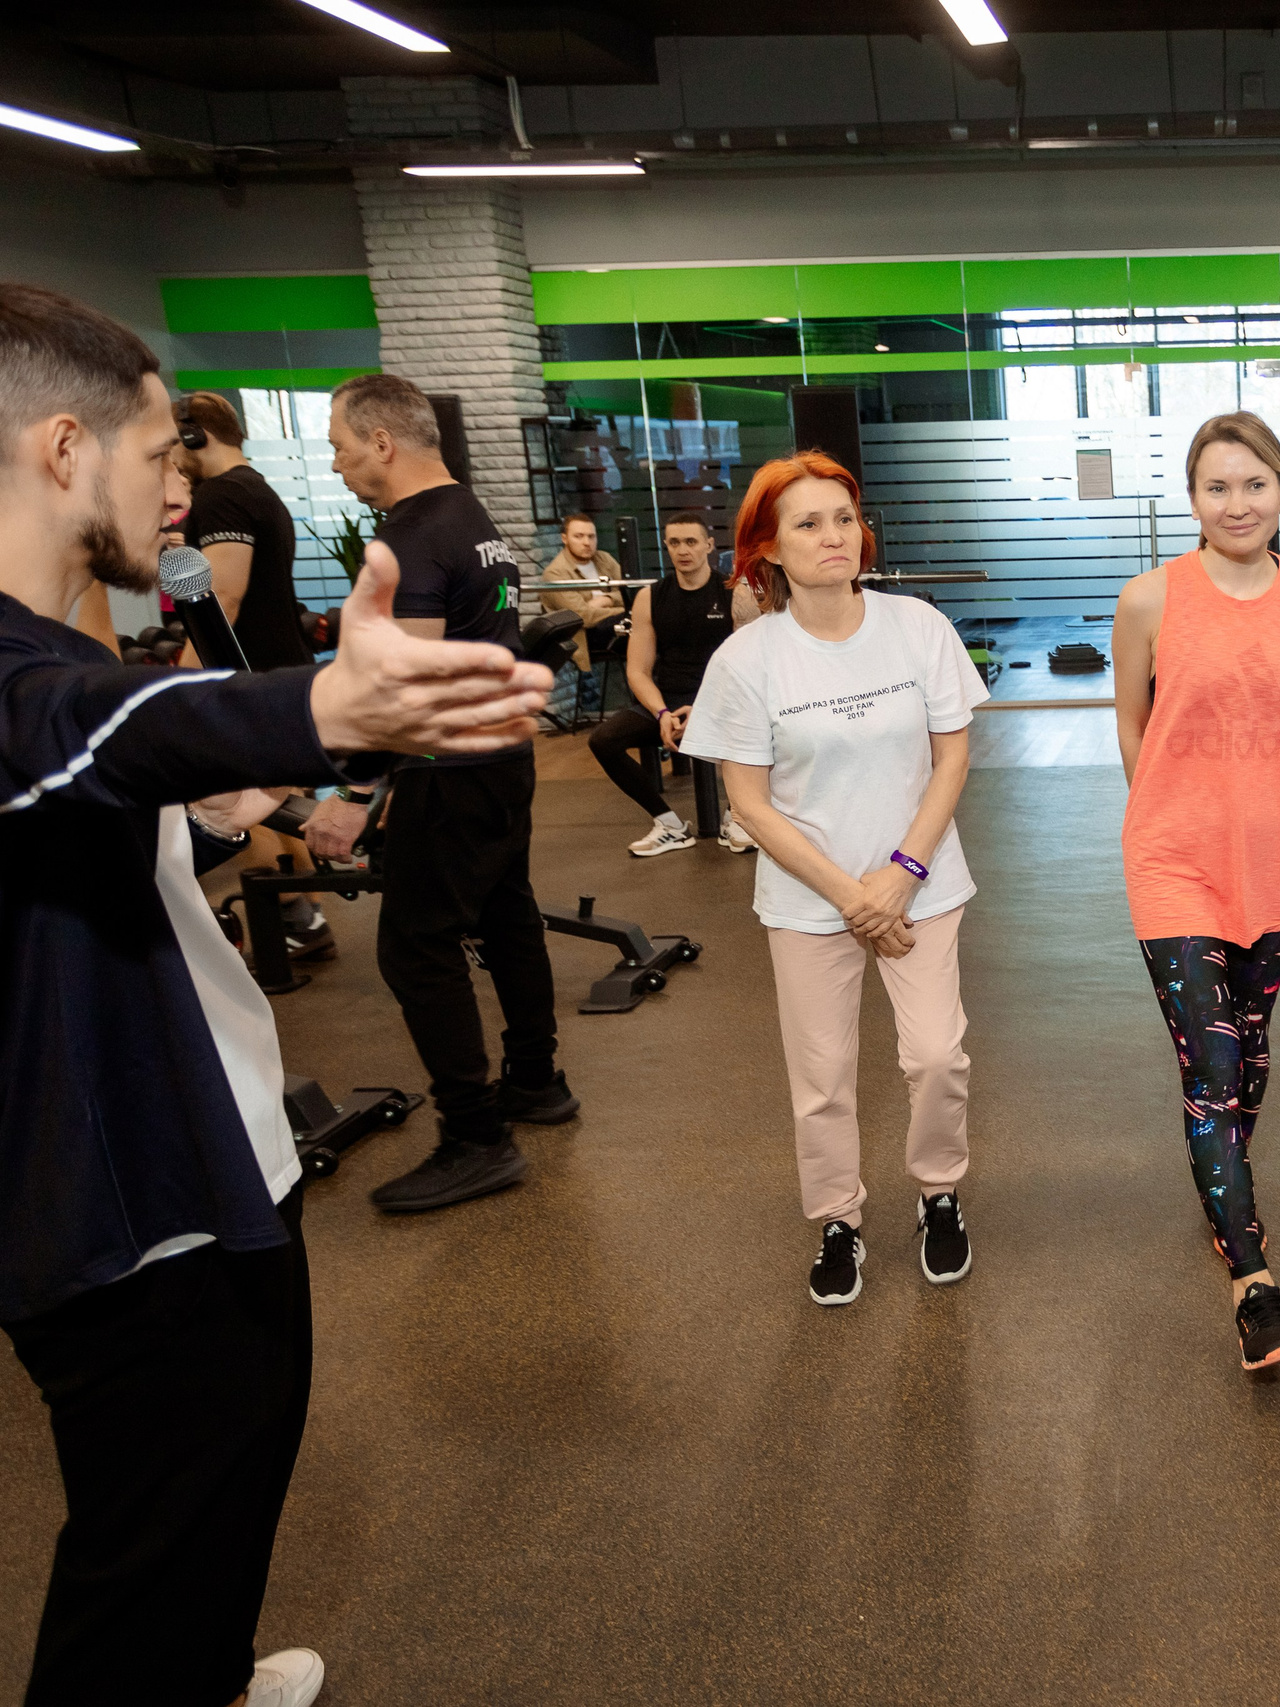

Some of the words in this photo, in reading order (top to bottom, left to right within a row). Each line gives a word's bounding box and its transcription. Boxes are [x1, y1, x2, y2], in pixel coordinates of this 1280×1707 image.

[812, 701, 828, 710] РАЗ
[837, 687, 890, 706] ВСПОМИНАЮ
[832, 705, 855, 715] RAUF
[856, 700, 875, 711] FAIK
[847, 711, 865, 720] 2019
